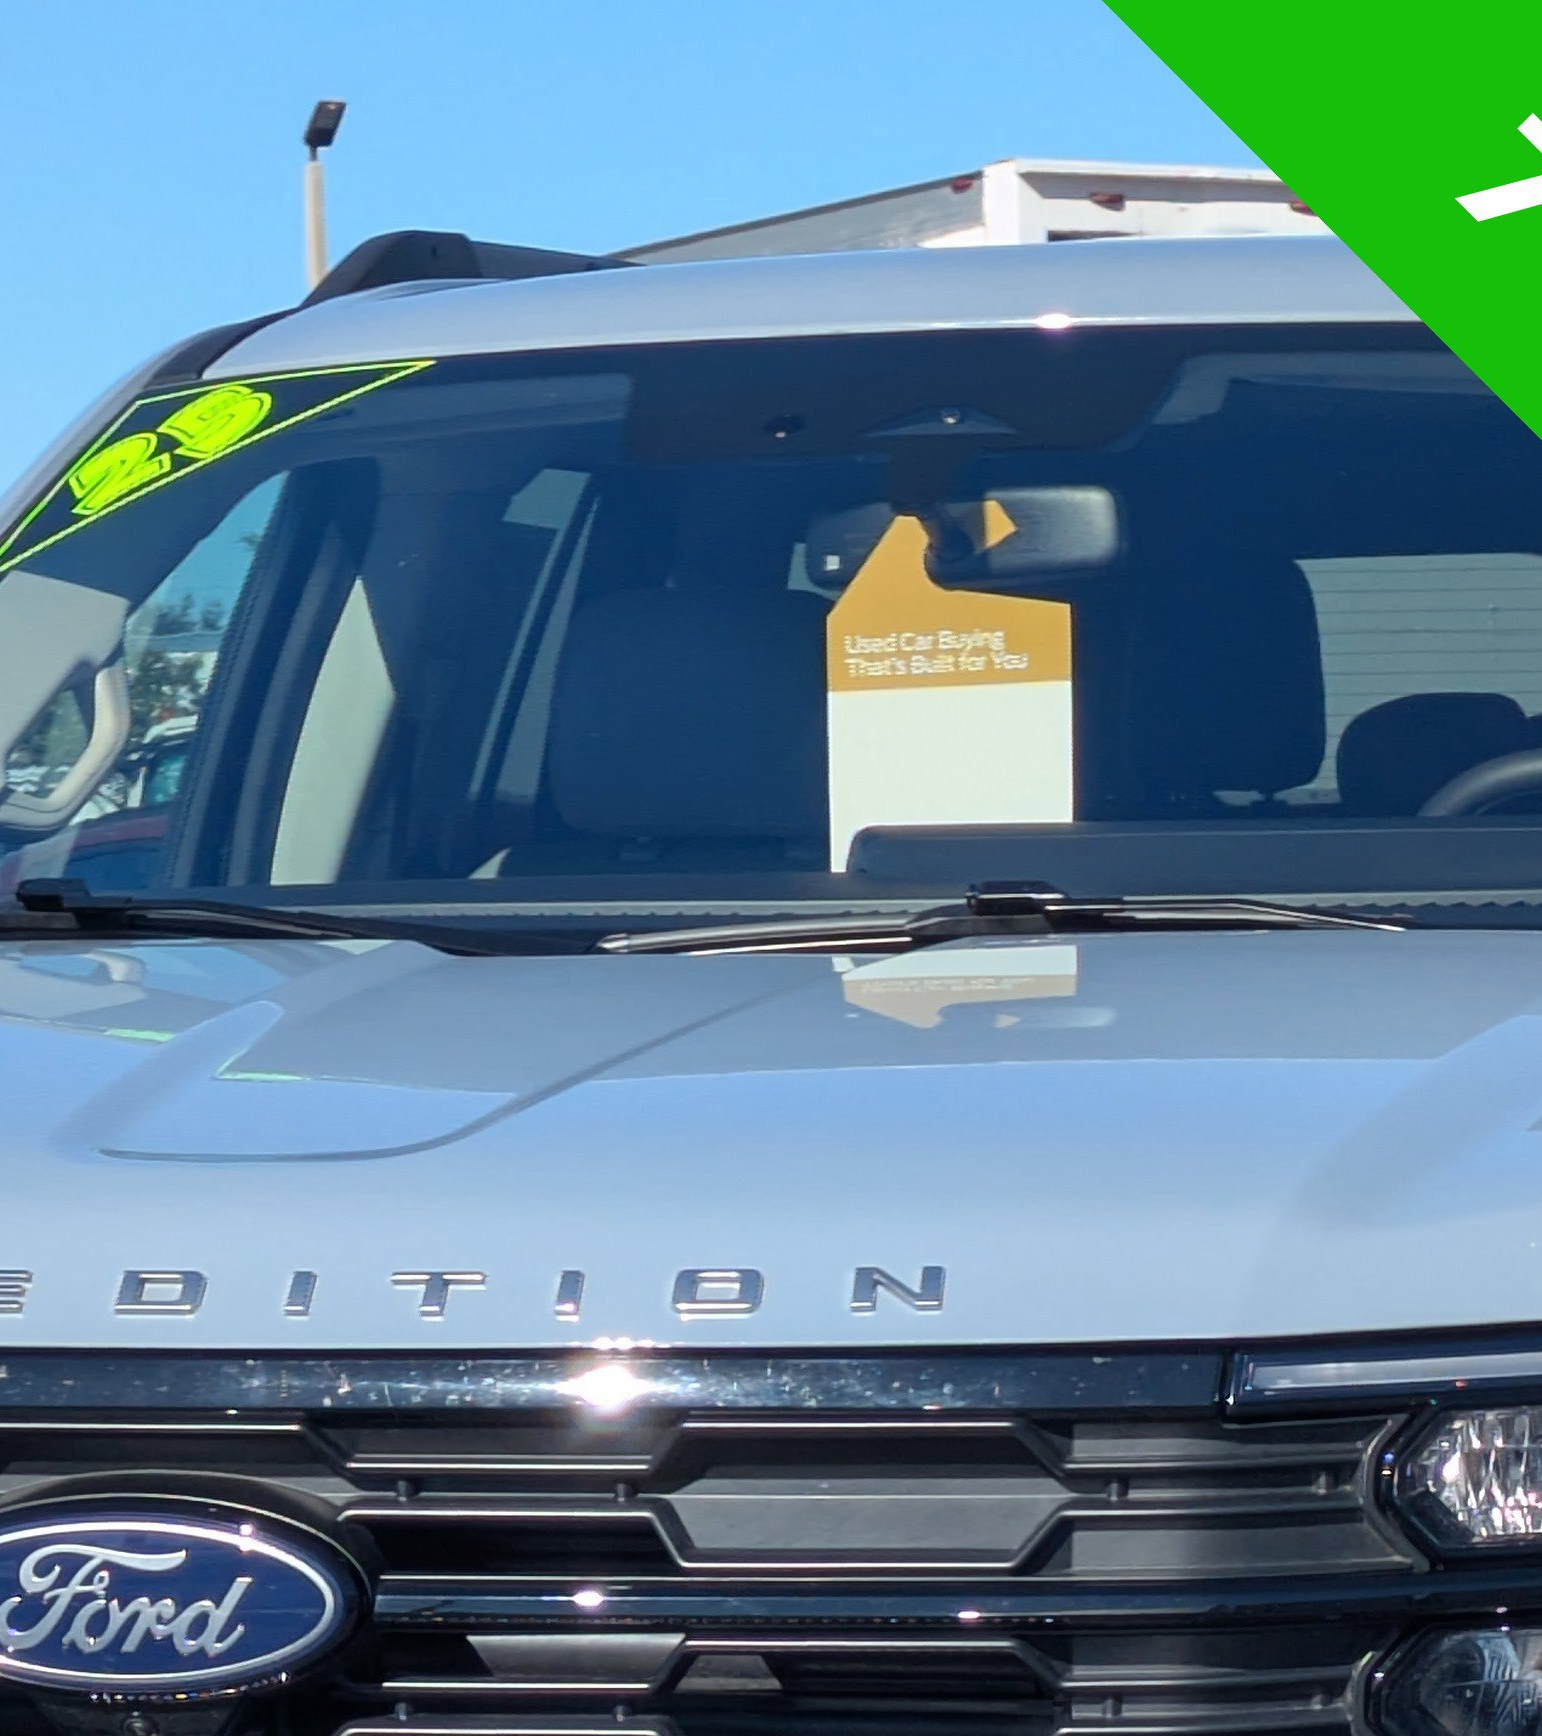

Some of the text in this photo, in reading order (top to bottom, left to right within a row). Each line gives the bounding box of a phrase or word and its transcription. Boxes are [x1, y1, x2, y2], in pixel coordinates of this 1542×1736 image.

[68, 384, 273, 516] 25
[843, 628, 1006, 655] Used Car Buying
[843, 651, 1029, 677] That's Built for You
